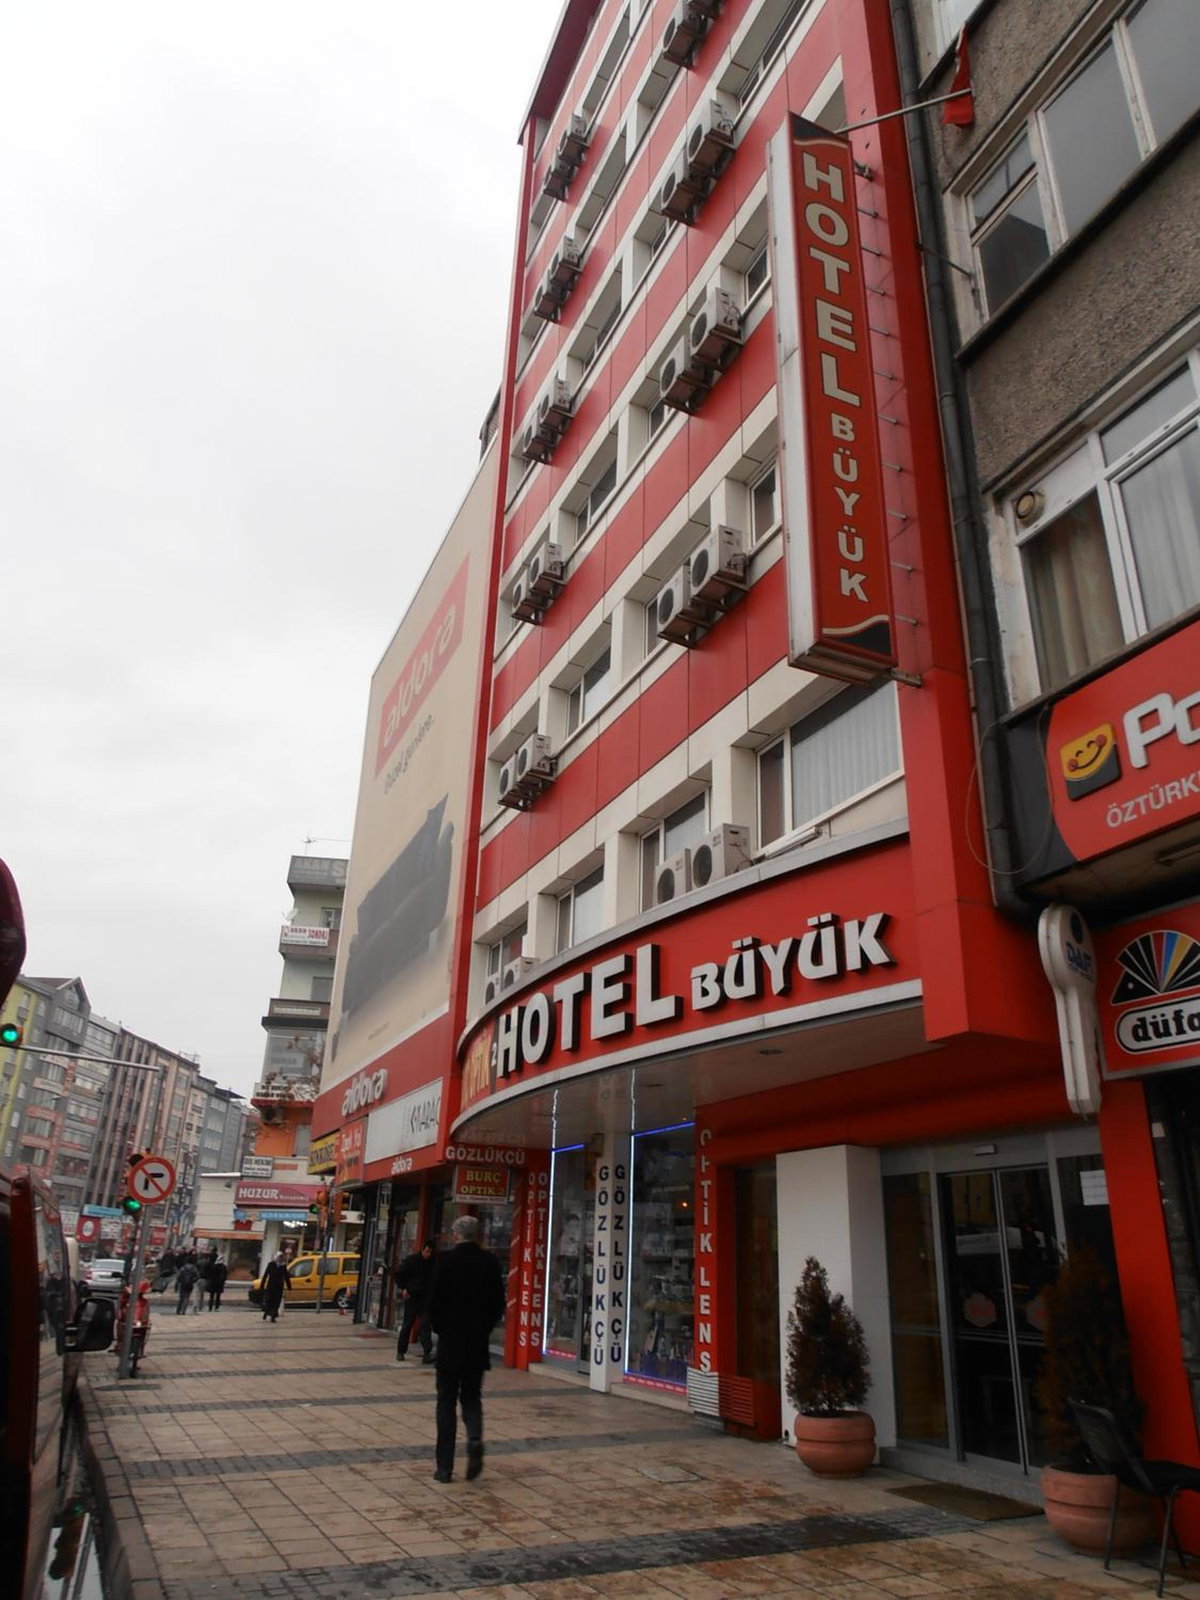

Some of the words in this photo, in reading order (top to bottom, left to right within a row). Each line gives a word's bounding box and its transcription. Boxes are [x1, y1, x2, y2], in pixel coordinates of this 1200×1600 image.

[802, 151, 861, 408] HOTEL
[829, 411, 869, 604] BÜYÜK
[1106, 770, 1200, 828] ÖZTÜRK
[497, 943, 682, 1077] HOTEL
[690, 912, 895, 1011] BÜYÜK
[238, 1187, 280, 1200] HUZUR
[594, 1165, 609, 1366] GÖZLÜKÇÜ
[610, 1164, 626, 1363] GÖZLÜKÇÜ
[699, 1267, 712, 1373] LENS
